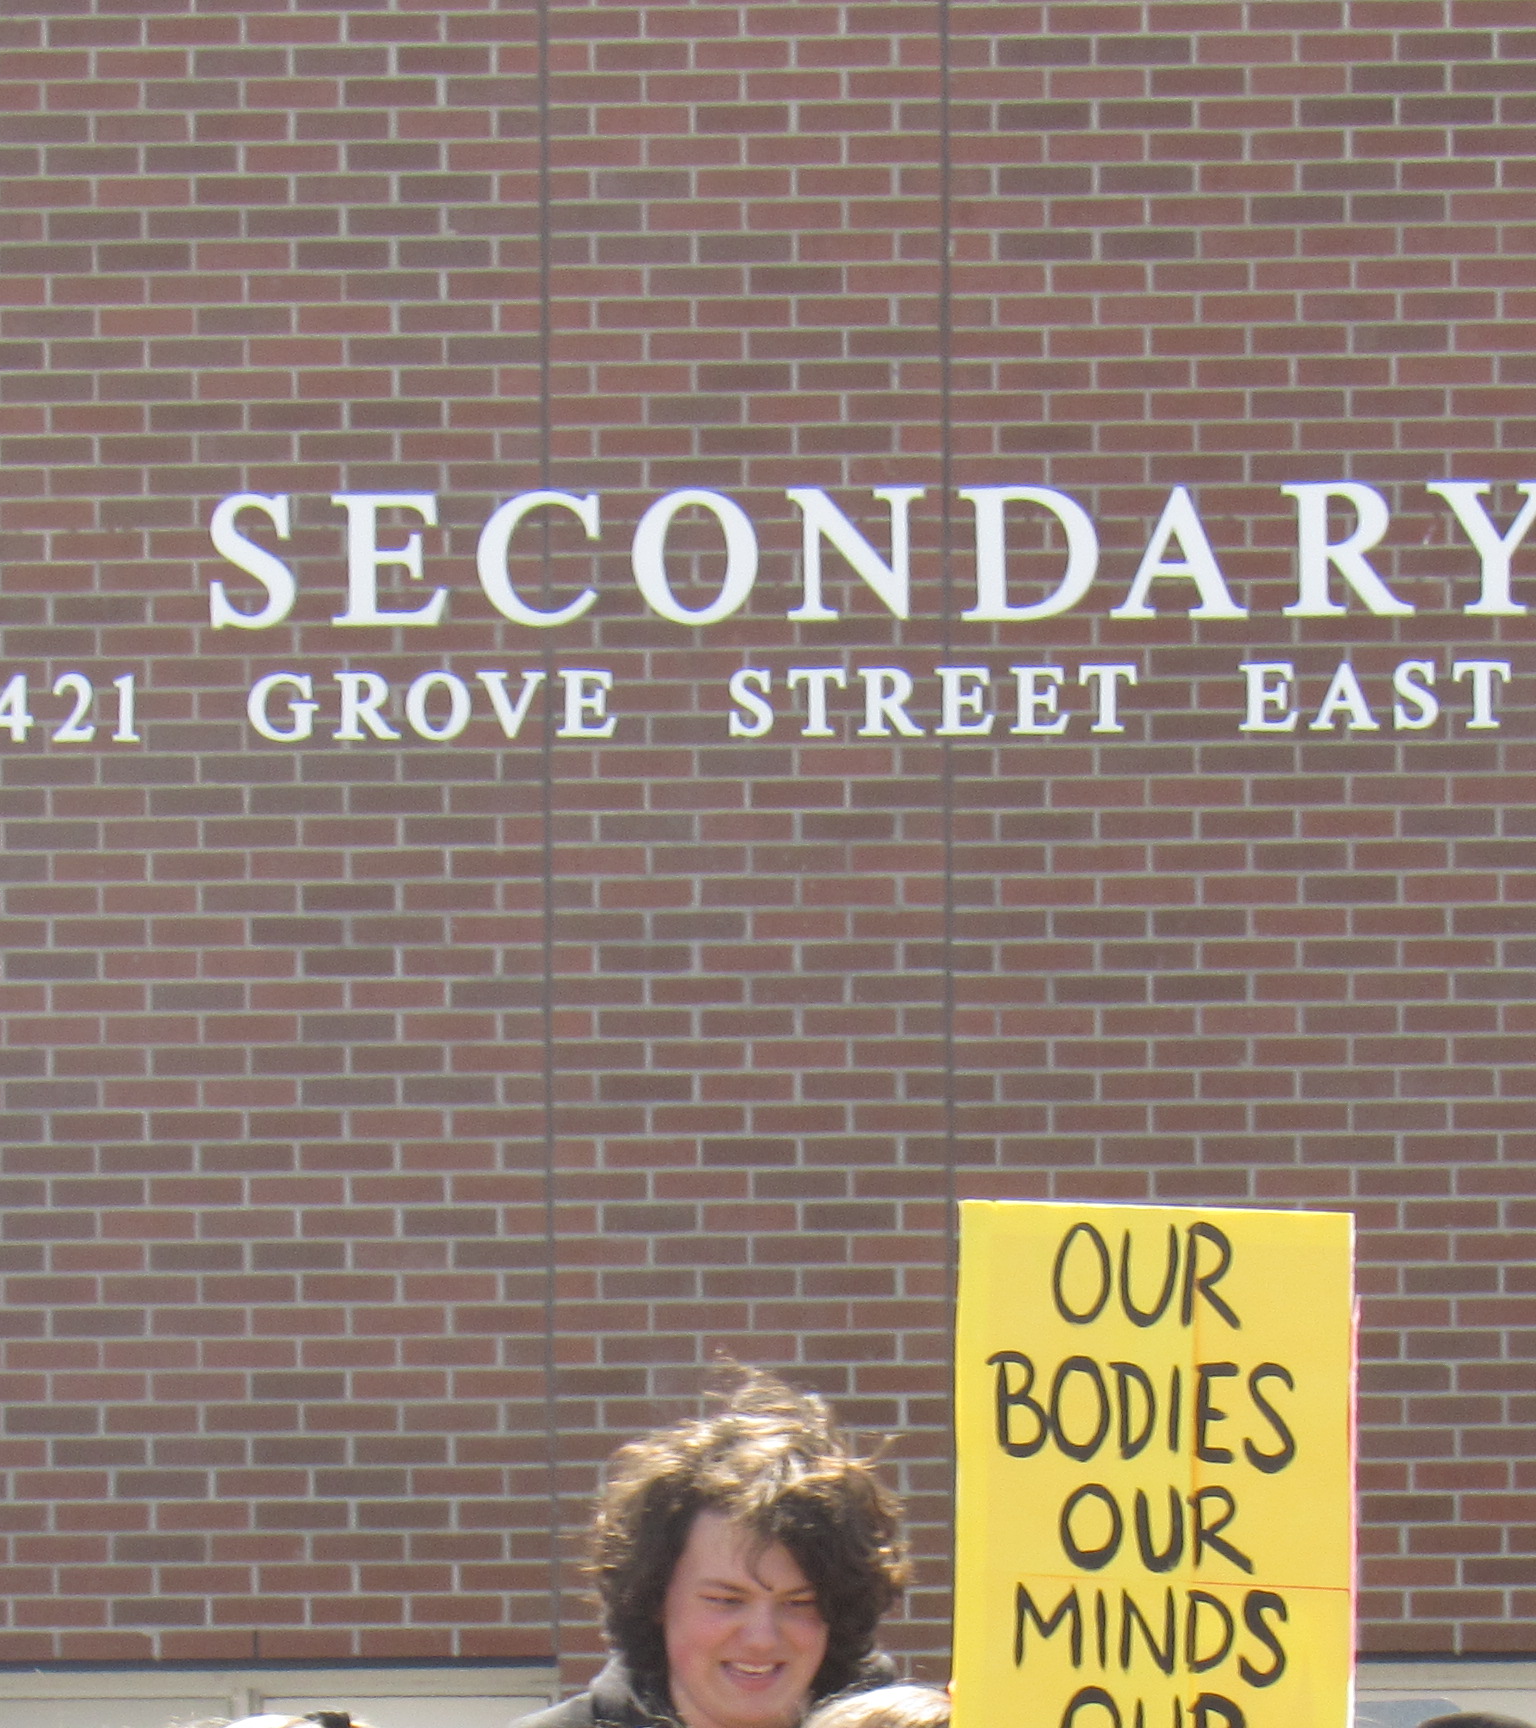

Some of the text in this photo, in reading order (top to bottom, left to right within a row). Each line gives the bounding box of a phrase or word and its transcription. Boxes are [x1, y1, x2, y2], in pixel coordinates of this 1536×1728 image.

[247, 669, 617, 741] GROVE
[729, 664, 1139, 737] STREET
[1238, 660, 1513, 731] EAST
[1052, 1221, 1242, 1330] OUR
[986, 1350, 1296, 1475] BODIES
[1059, 1482, 1254, 1574] OUR
[1013, 1581, 1288, 1688] MINDS
